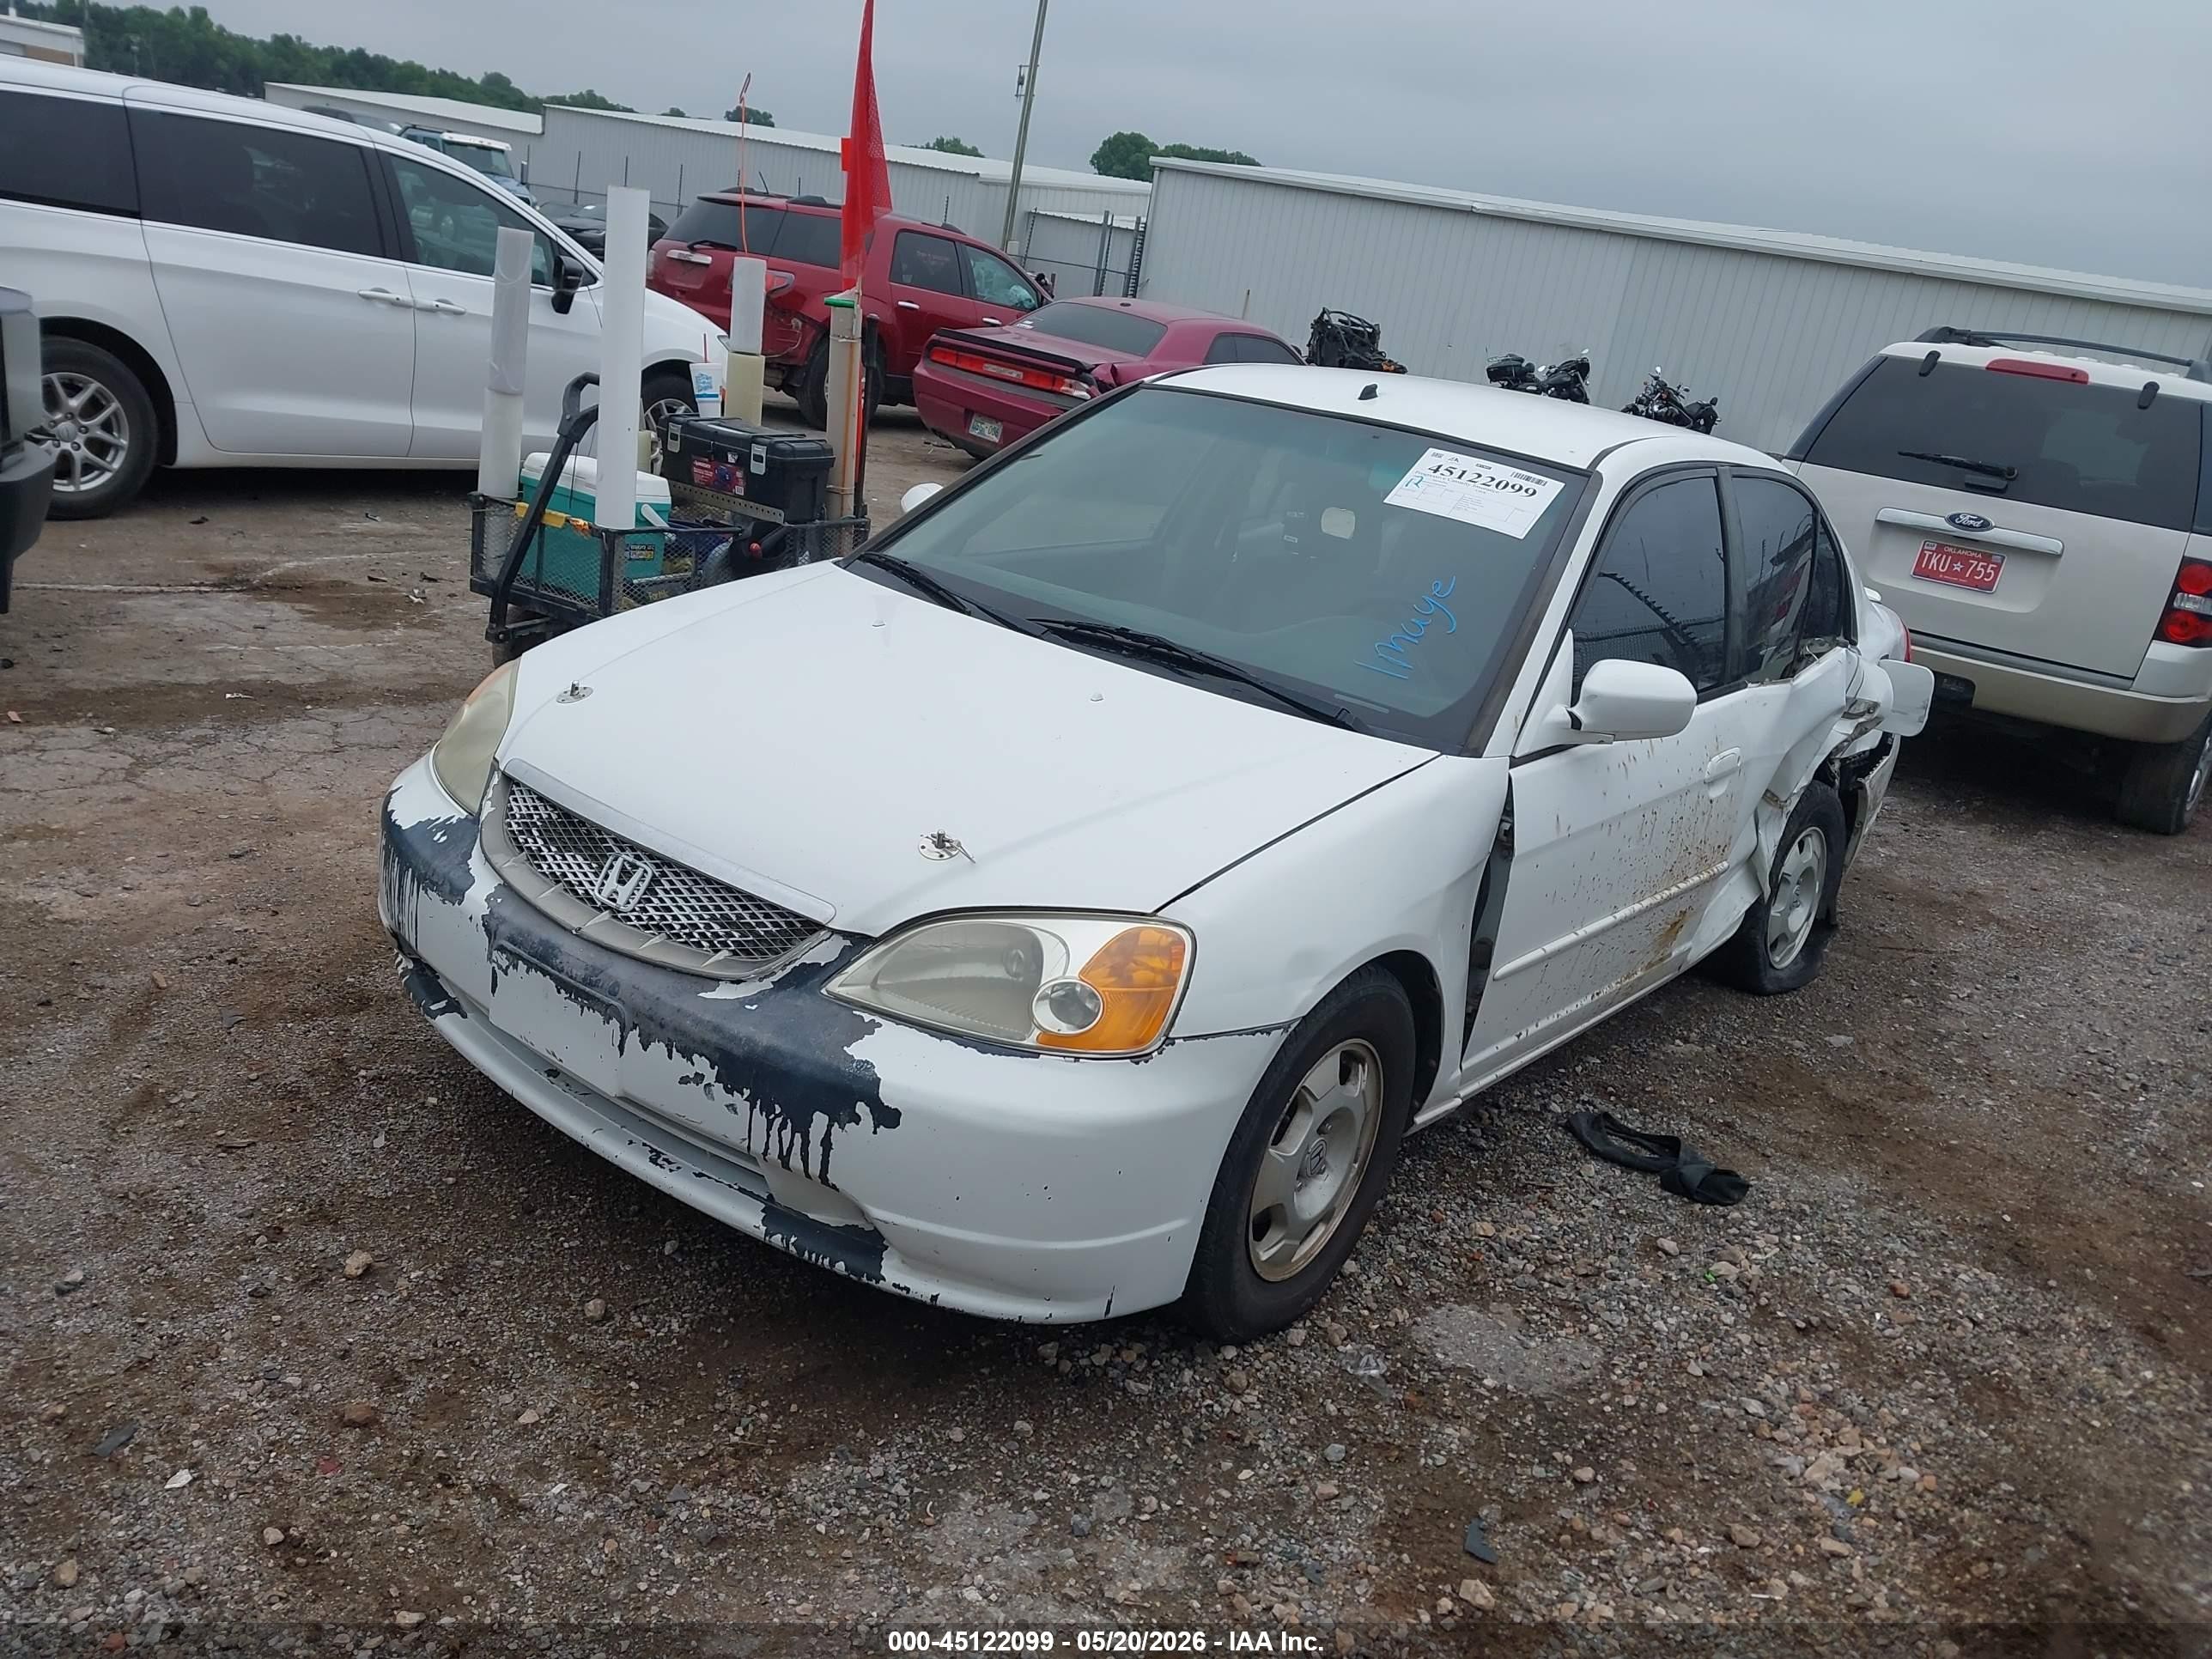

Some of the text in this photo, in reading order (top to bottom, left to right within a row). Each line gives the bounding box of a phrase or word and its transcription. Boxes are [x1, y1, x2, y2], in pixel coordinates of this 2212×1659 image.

[1428, 464, 1537, 498] 45122099
[1954, 514, 1984, 528] Ford
[1943, 545, 1982, 558] OKLAHOMA
[1922, 550, 1998, 582] TKU 755
